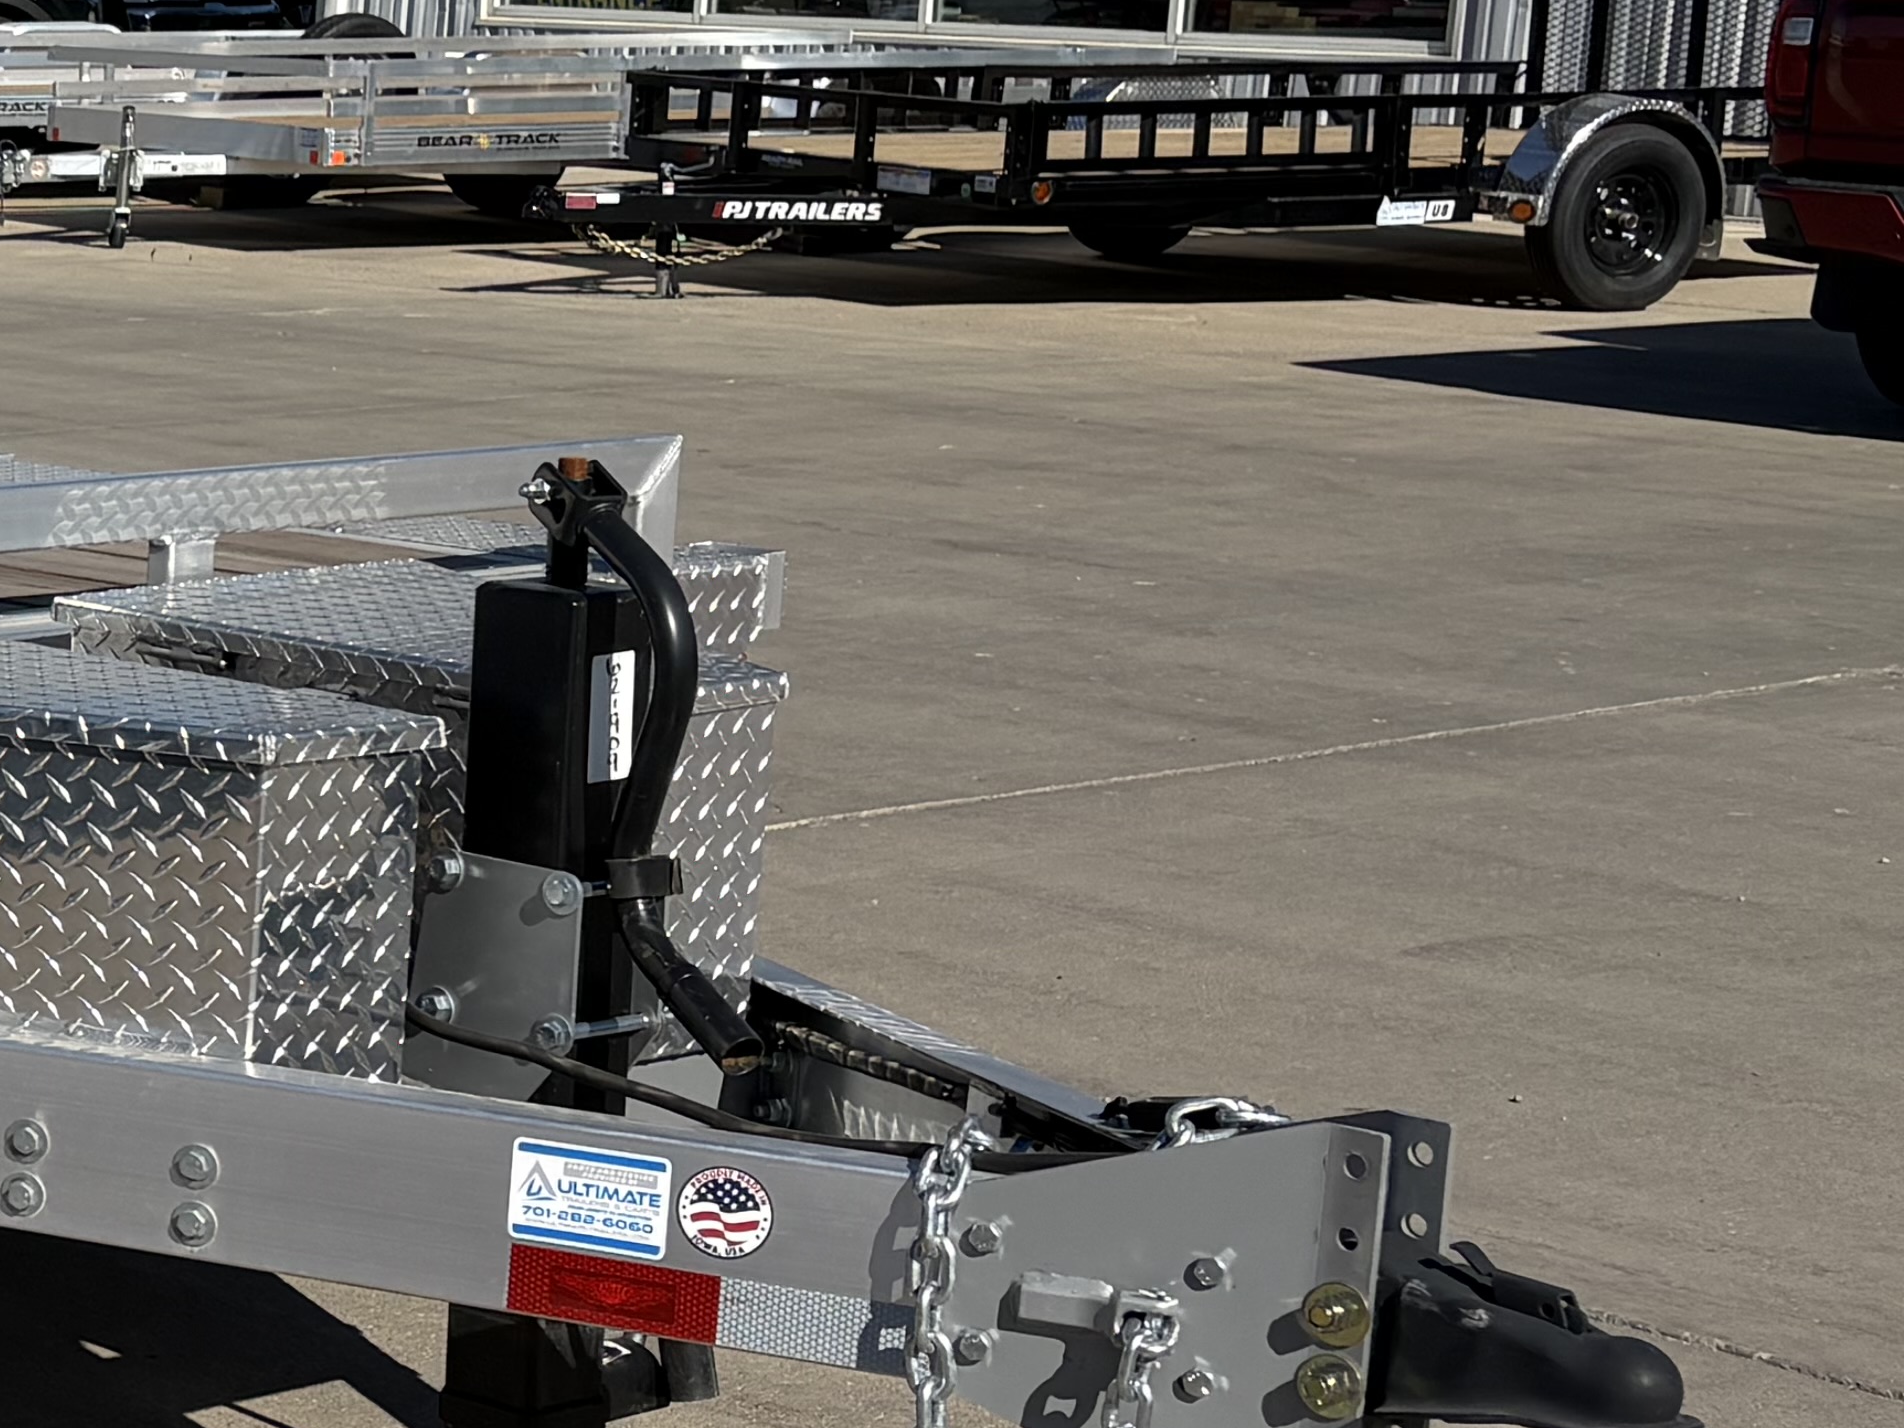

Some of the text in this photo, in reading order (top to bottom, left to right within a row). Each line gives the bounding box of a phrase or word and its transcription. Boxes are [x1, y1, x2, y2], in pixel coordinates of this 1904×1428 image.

[417, 133, 560, 148] BEAR TRACK
[755, 201, 884, 222] TRAILERS
[557, 1178, 662, 1209] ULTIMATE
